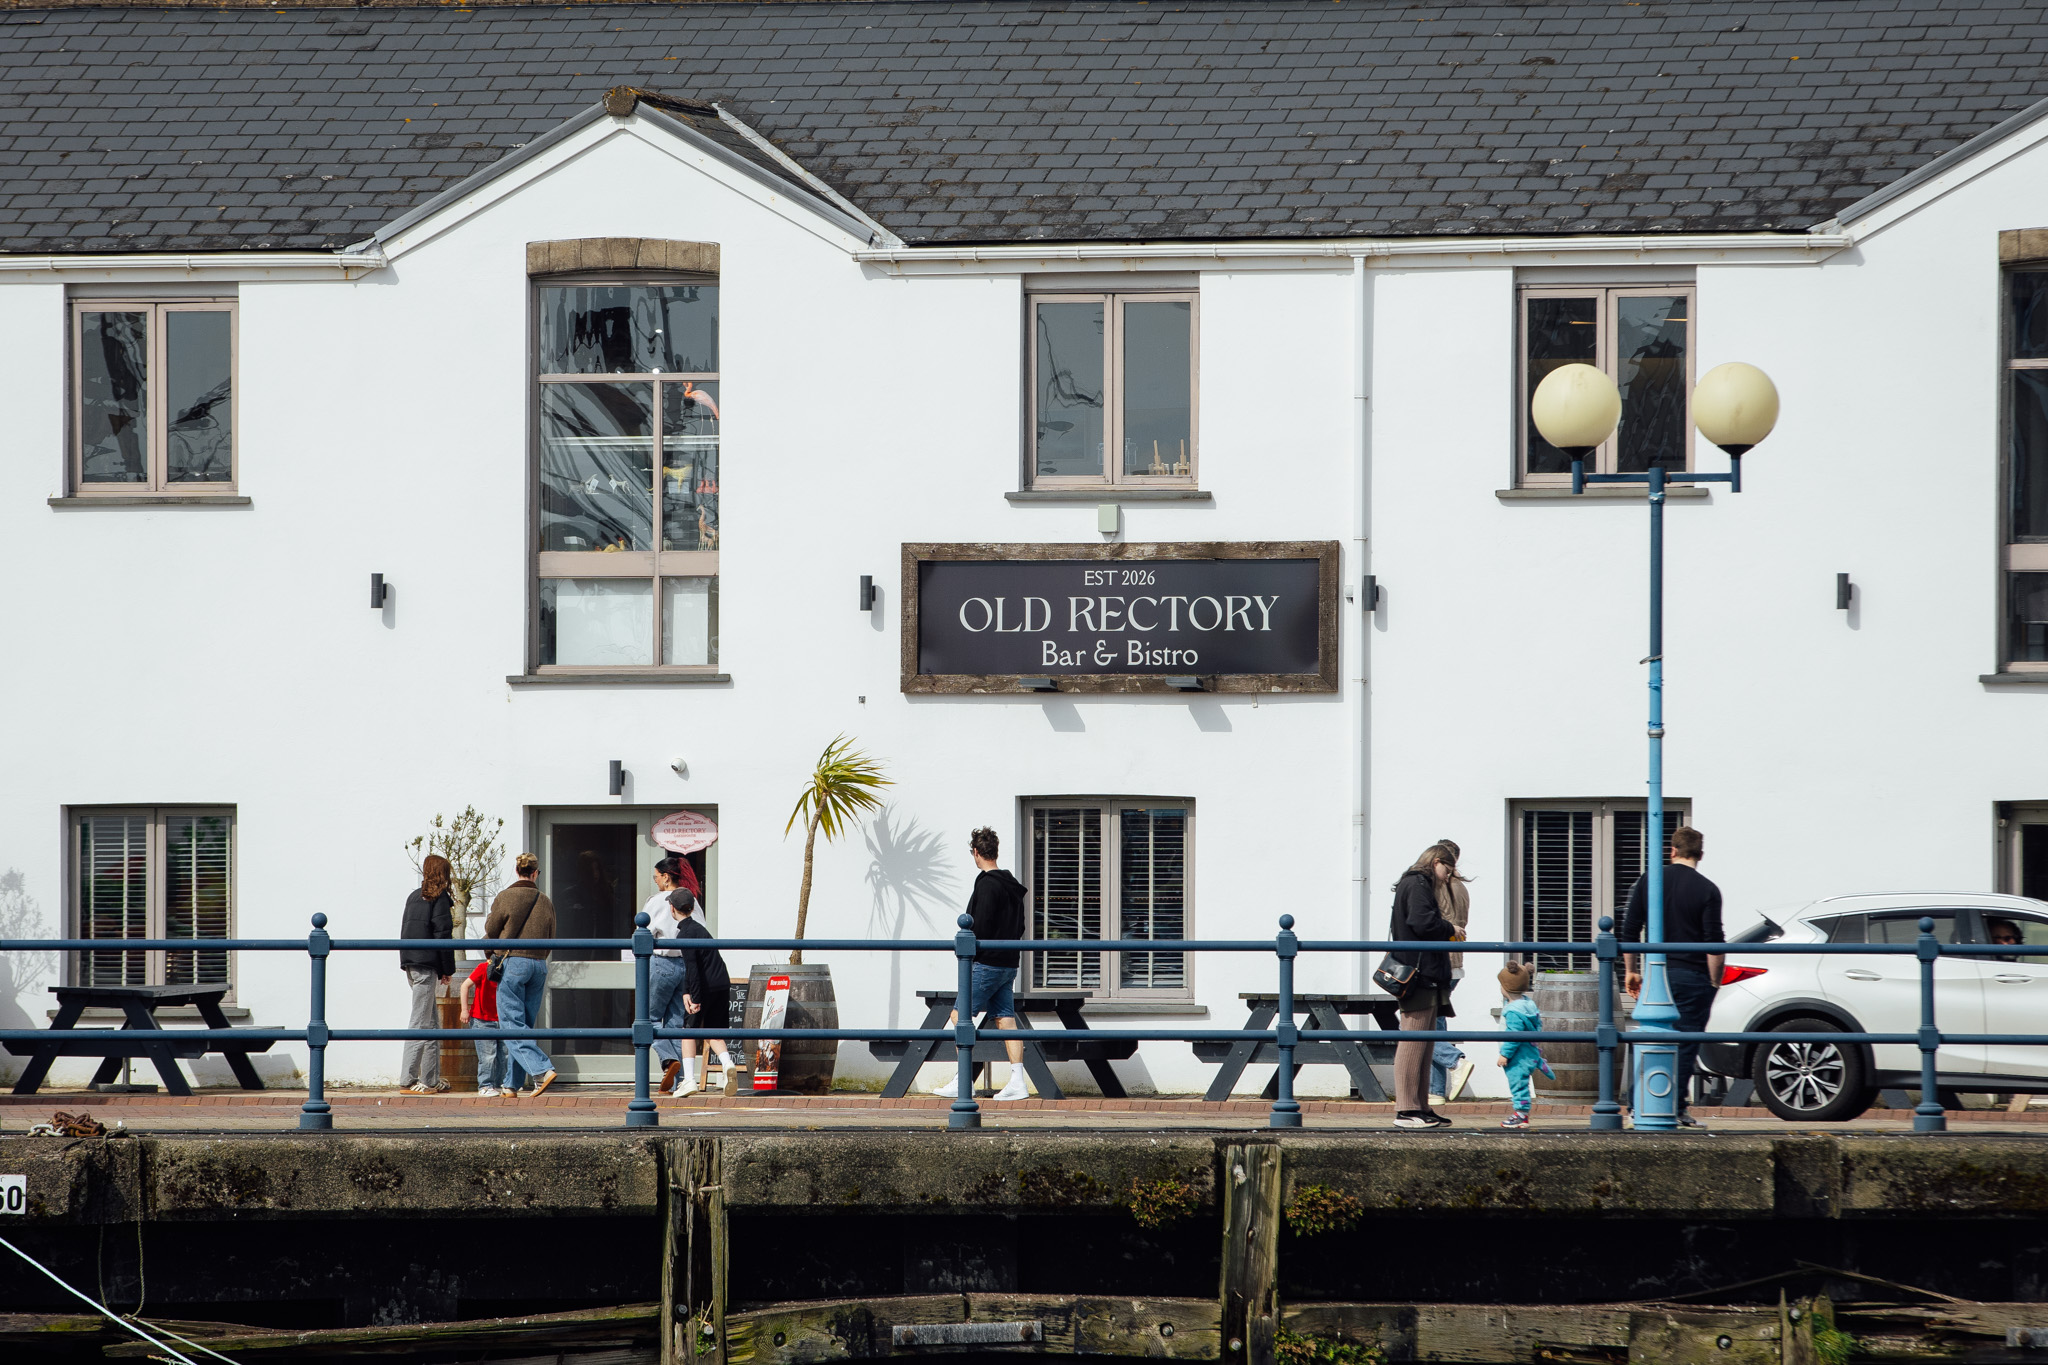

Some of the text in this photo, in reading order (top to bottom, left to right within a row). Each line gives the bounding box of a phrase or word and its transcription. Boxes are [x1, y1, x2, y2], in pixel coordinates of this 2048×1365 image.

[1084, 569, 1156, 586] EST 2026
[959, 595, 1280, 633] OLD RECTORY
[1041, 639, 1199, 667] Bar & Bistro
